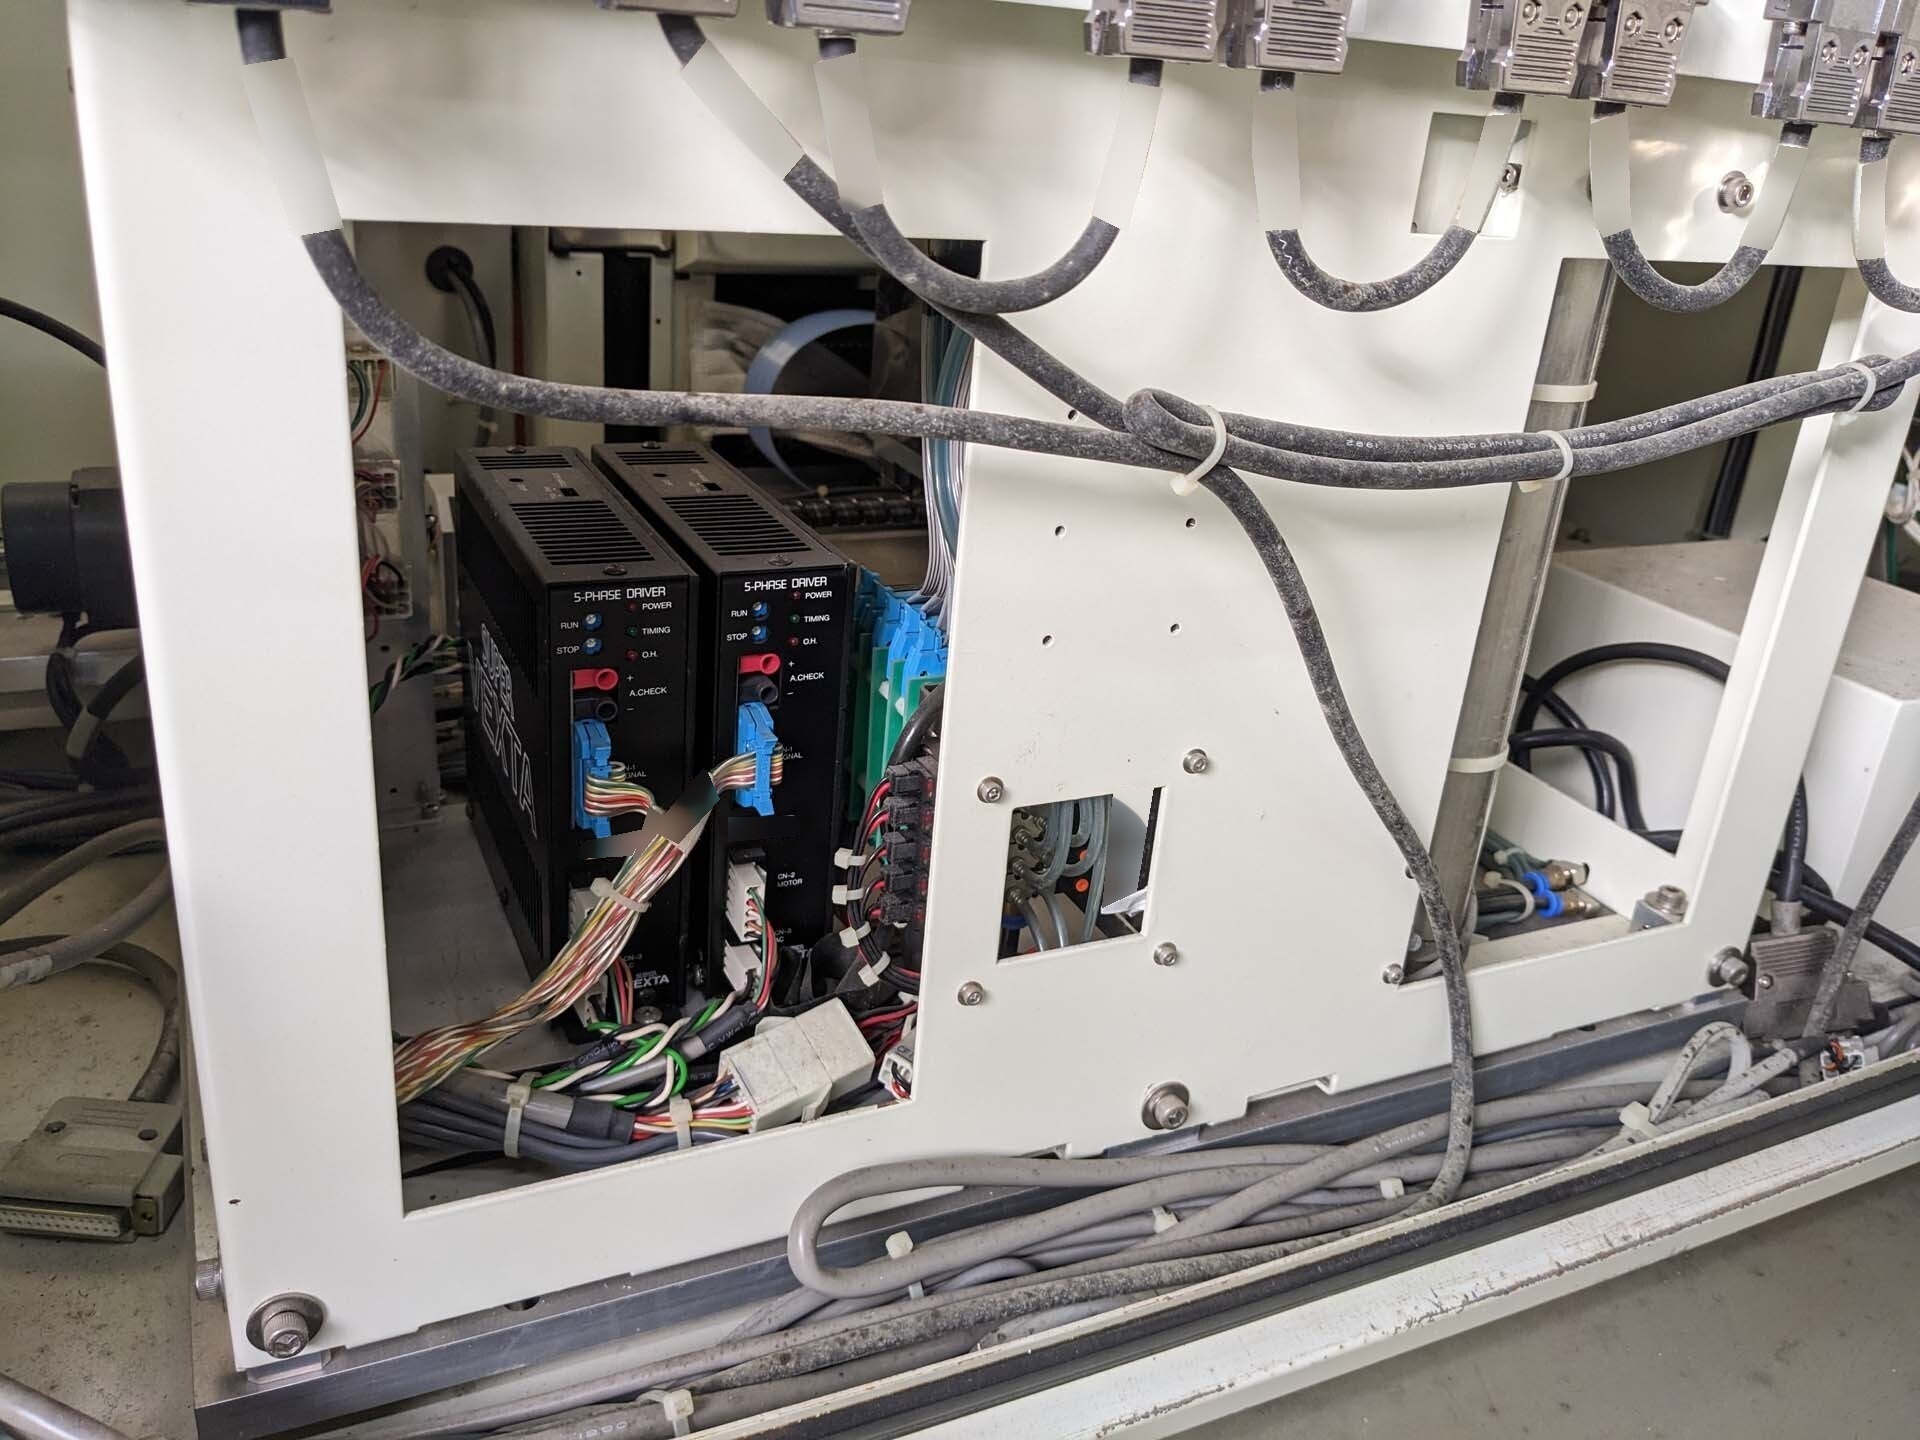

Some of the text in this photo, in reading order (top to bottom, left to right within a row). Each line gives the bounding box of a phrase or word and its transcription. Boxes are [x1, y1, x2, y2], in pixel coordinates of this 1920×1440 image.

[744, 576, 828, 592] 5-PHASE DRIVER
[574, 586, 666, 603] 5-PHASE DRIVER
[805, 591, 832, 599] POWER
[642, 601, 672, 611] POWER
[804, 614, 830, 623] TIMING
[560, 621, 579, 630] RUN
[642, 626, 671, 635] TIMING
[726, 633, 748, 641] STOP
[556, 645, 580, 655] STOP
[789, 672, 825, 682] A.CHECK
[629, 686, 667, 697] A.CHECK
[777, 878, 803, 887] MOTOR
[632, 974, 670, 989] EXTA
